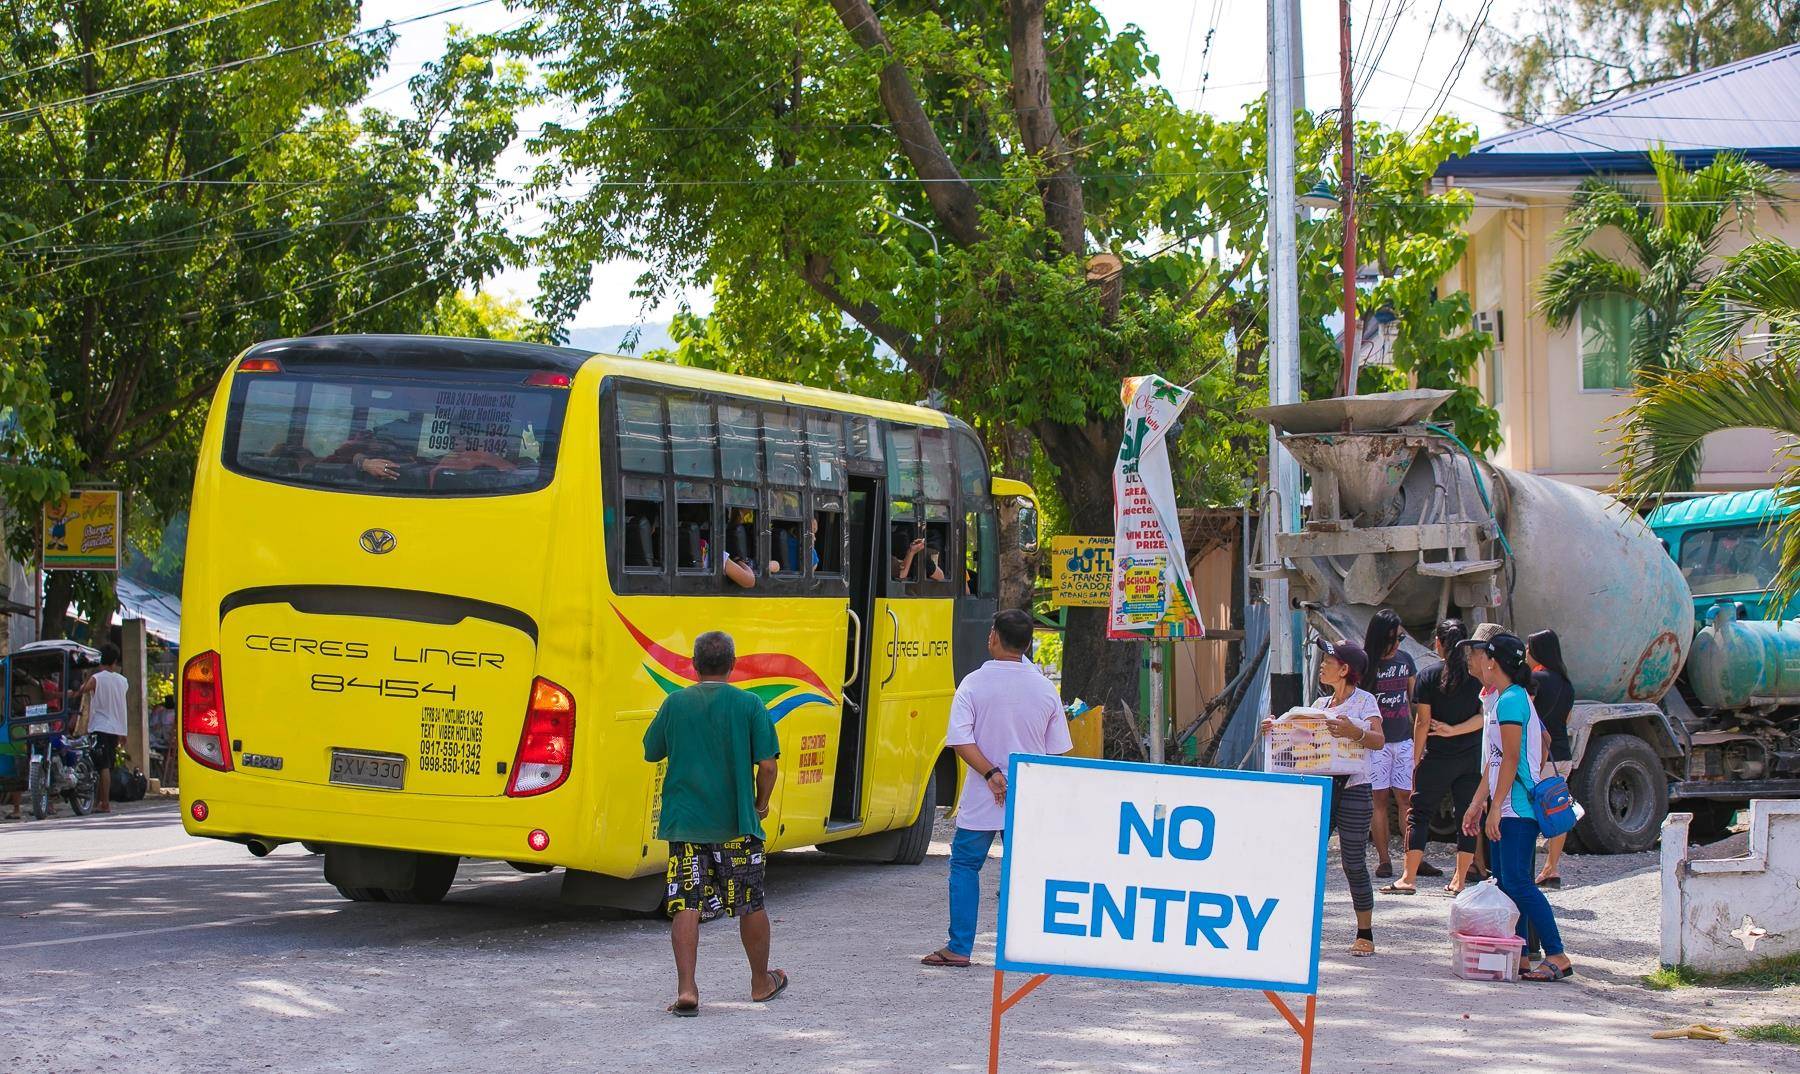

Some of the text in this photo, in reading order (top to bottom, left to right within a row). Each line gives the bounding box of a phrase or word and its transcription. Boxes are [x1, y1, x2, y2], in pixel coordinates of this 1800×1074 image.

[1141, 521, 1159, 529] PLU
[1126, 576, 1157, 585] SCHOLAR
[1135, 585, 1150, 593] SHIP
[245, 634, 368, 659] CERES
[311, 673, 456, 702] 8454
[466, 709, 484, 726] 1342
[421, 723, 435, 739] TEXT
[439, 724, 455, 740] VIBER
[455, 725, 483, 743] HOTLINES
[420, 740, 482, 759] 0917-550-1342
[419, 755, 481, 775] 0998-550-1342
[1118, 801, 1216, 861] NO
[683, 857, 694, 891] CLUB
[1043, 879, 1280, 951] ENTRY
